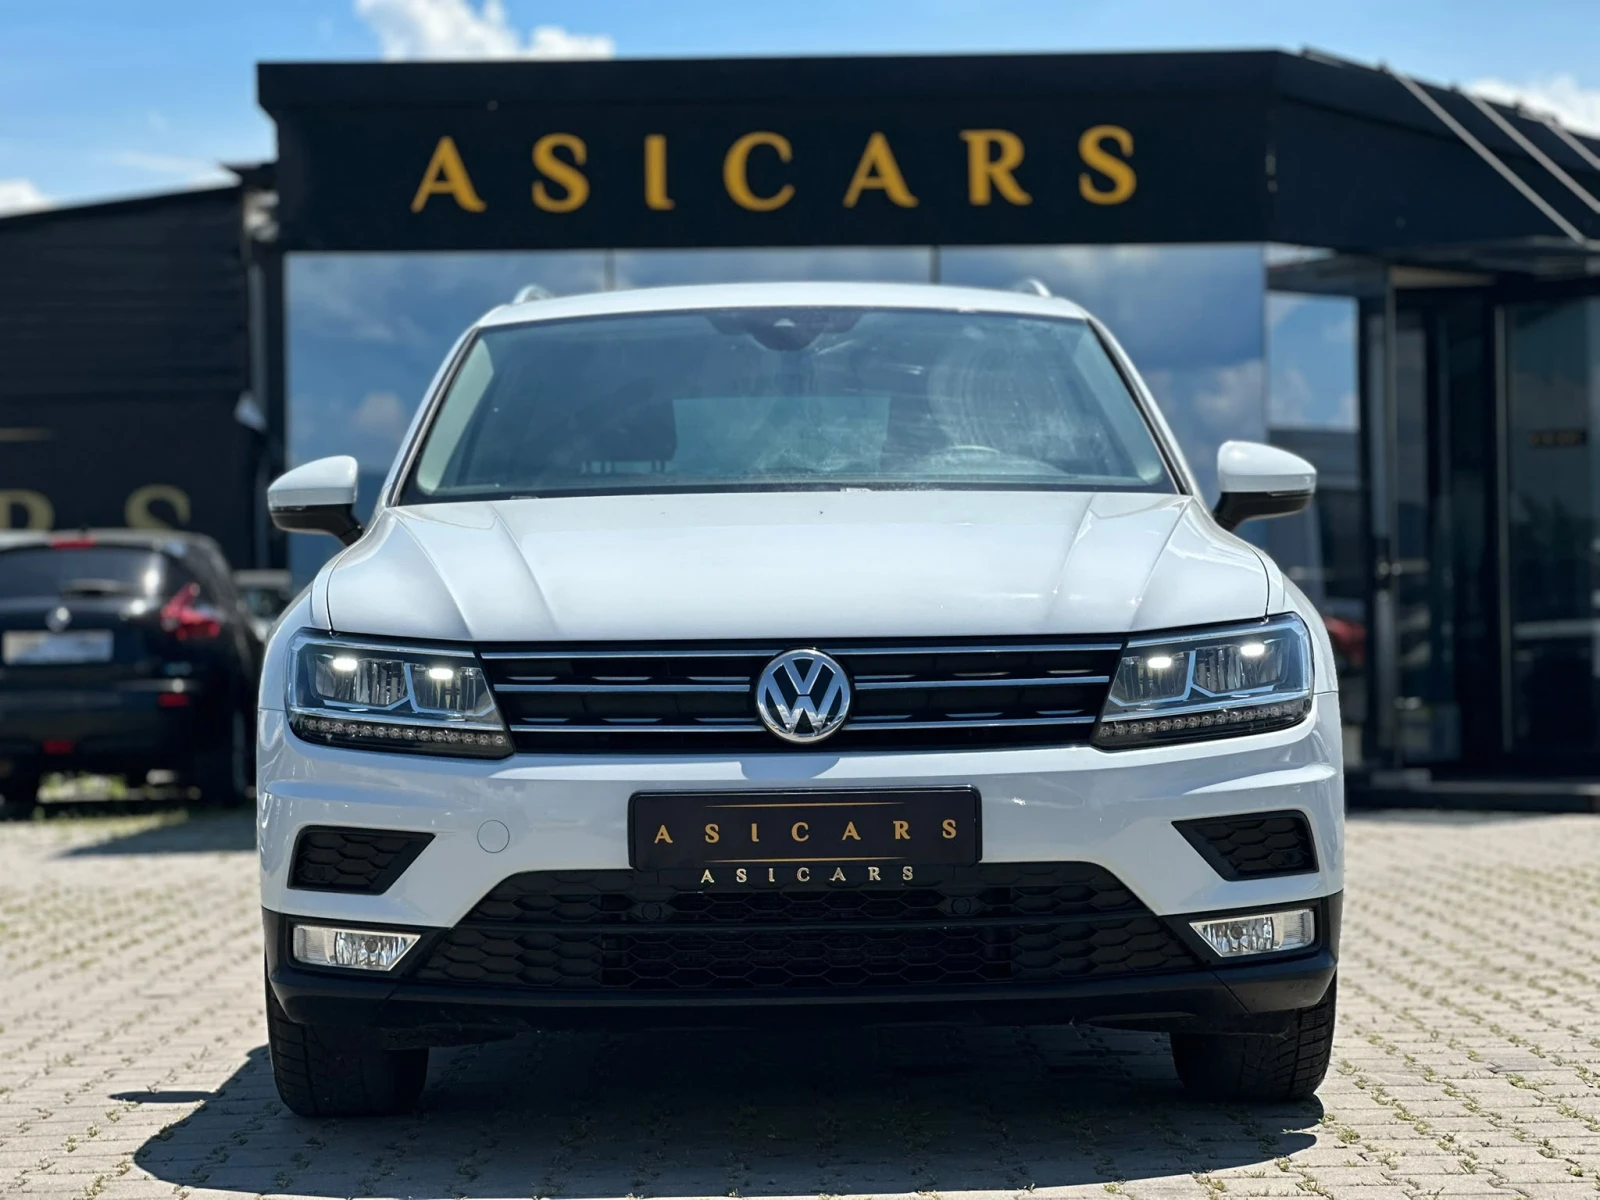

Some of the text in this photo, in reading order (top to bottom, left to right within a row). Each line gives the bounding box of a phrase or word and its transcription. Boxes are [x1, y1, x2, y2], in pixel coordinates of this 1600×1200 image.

[411, 125, 1137, 213] ASICARS
[654, 819, 957, 844] ASICARS
[700, 865, 914, 884] ASICARS
